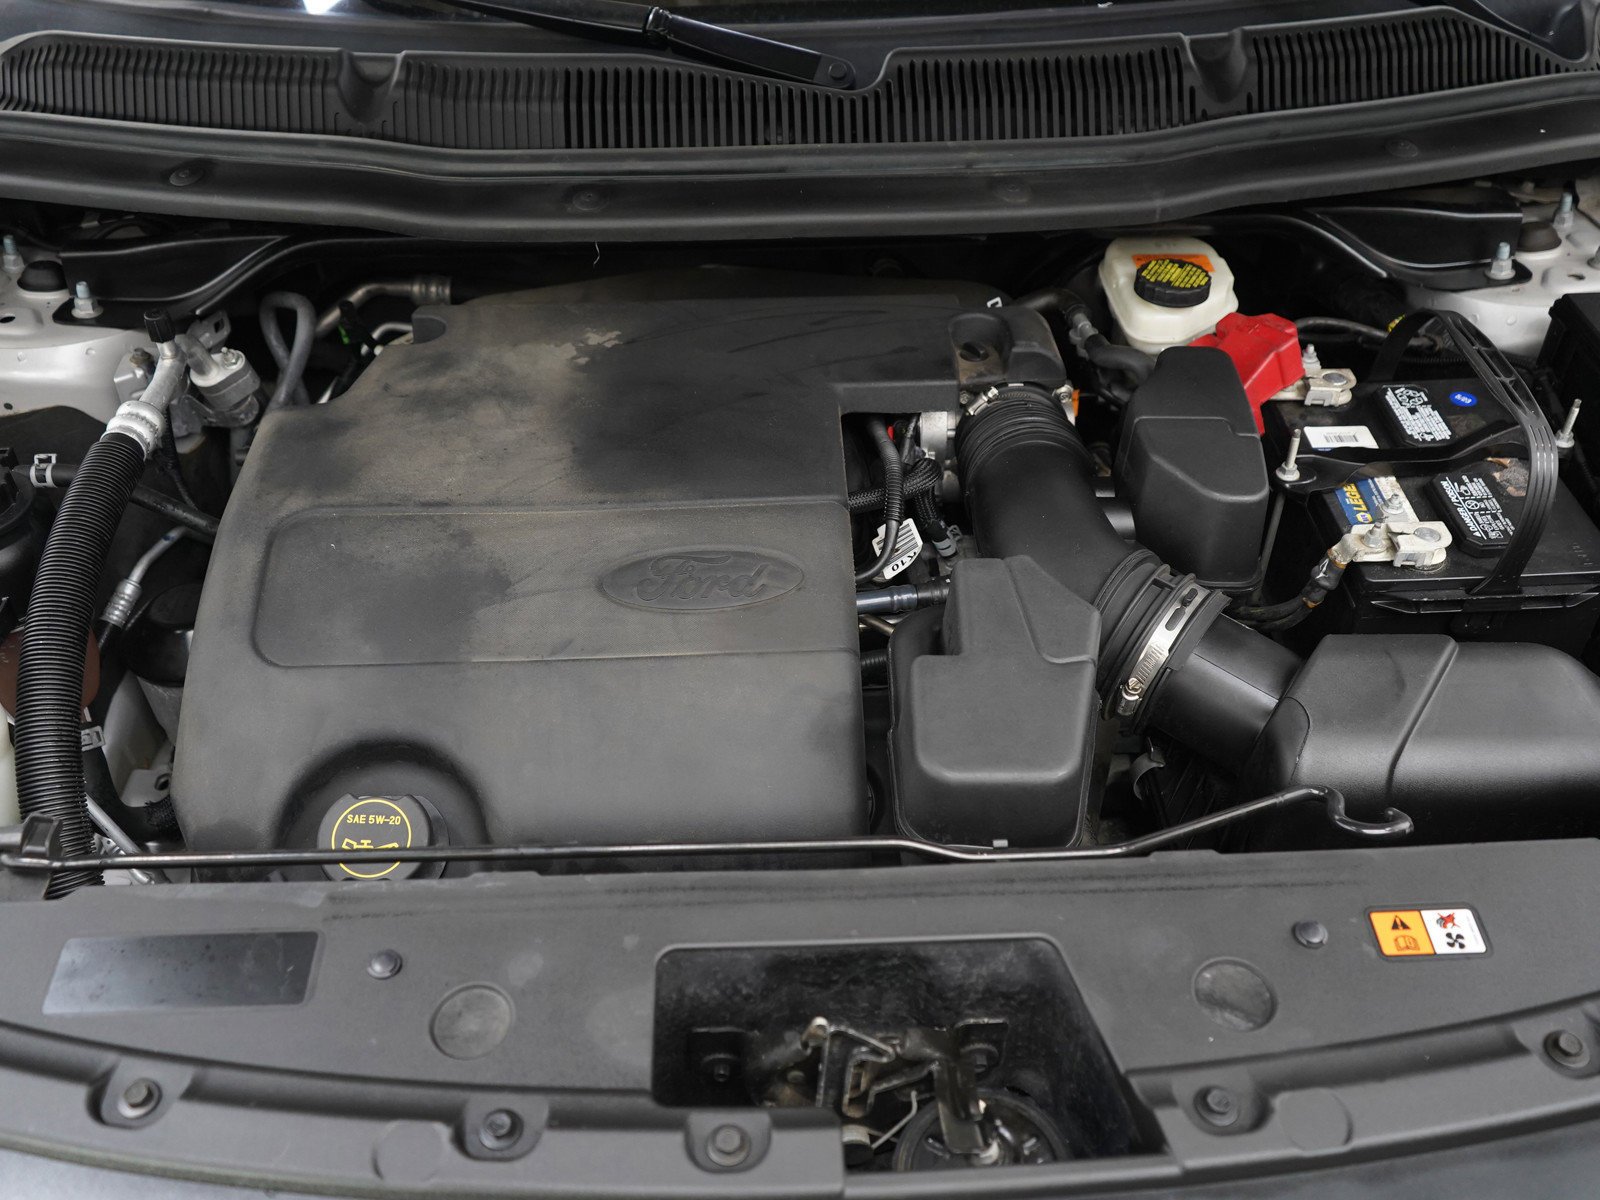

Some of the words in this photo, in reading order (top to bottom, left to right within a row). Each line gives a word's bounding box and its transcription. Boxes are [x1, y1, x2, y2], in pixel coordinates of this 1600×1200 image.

[1440, 480, 1460, 502] POISON
[1457, 507, 1478, 532] DANGER
[636, 554, 769, 601] Ford
[346, 814, 366, 824] SAE
[368, 815, 401, 825] 5W-20
